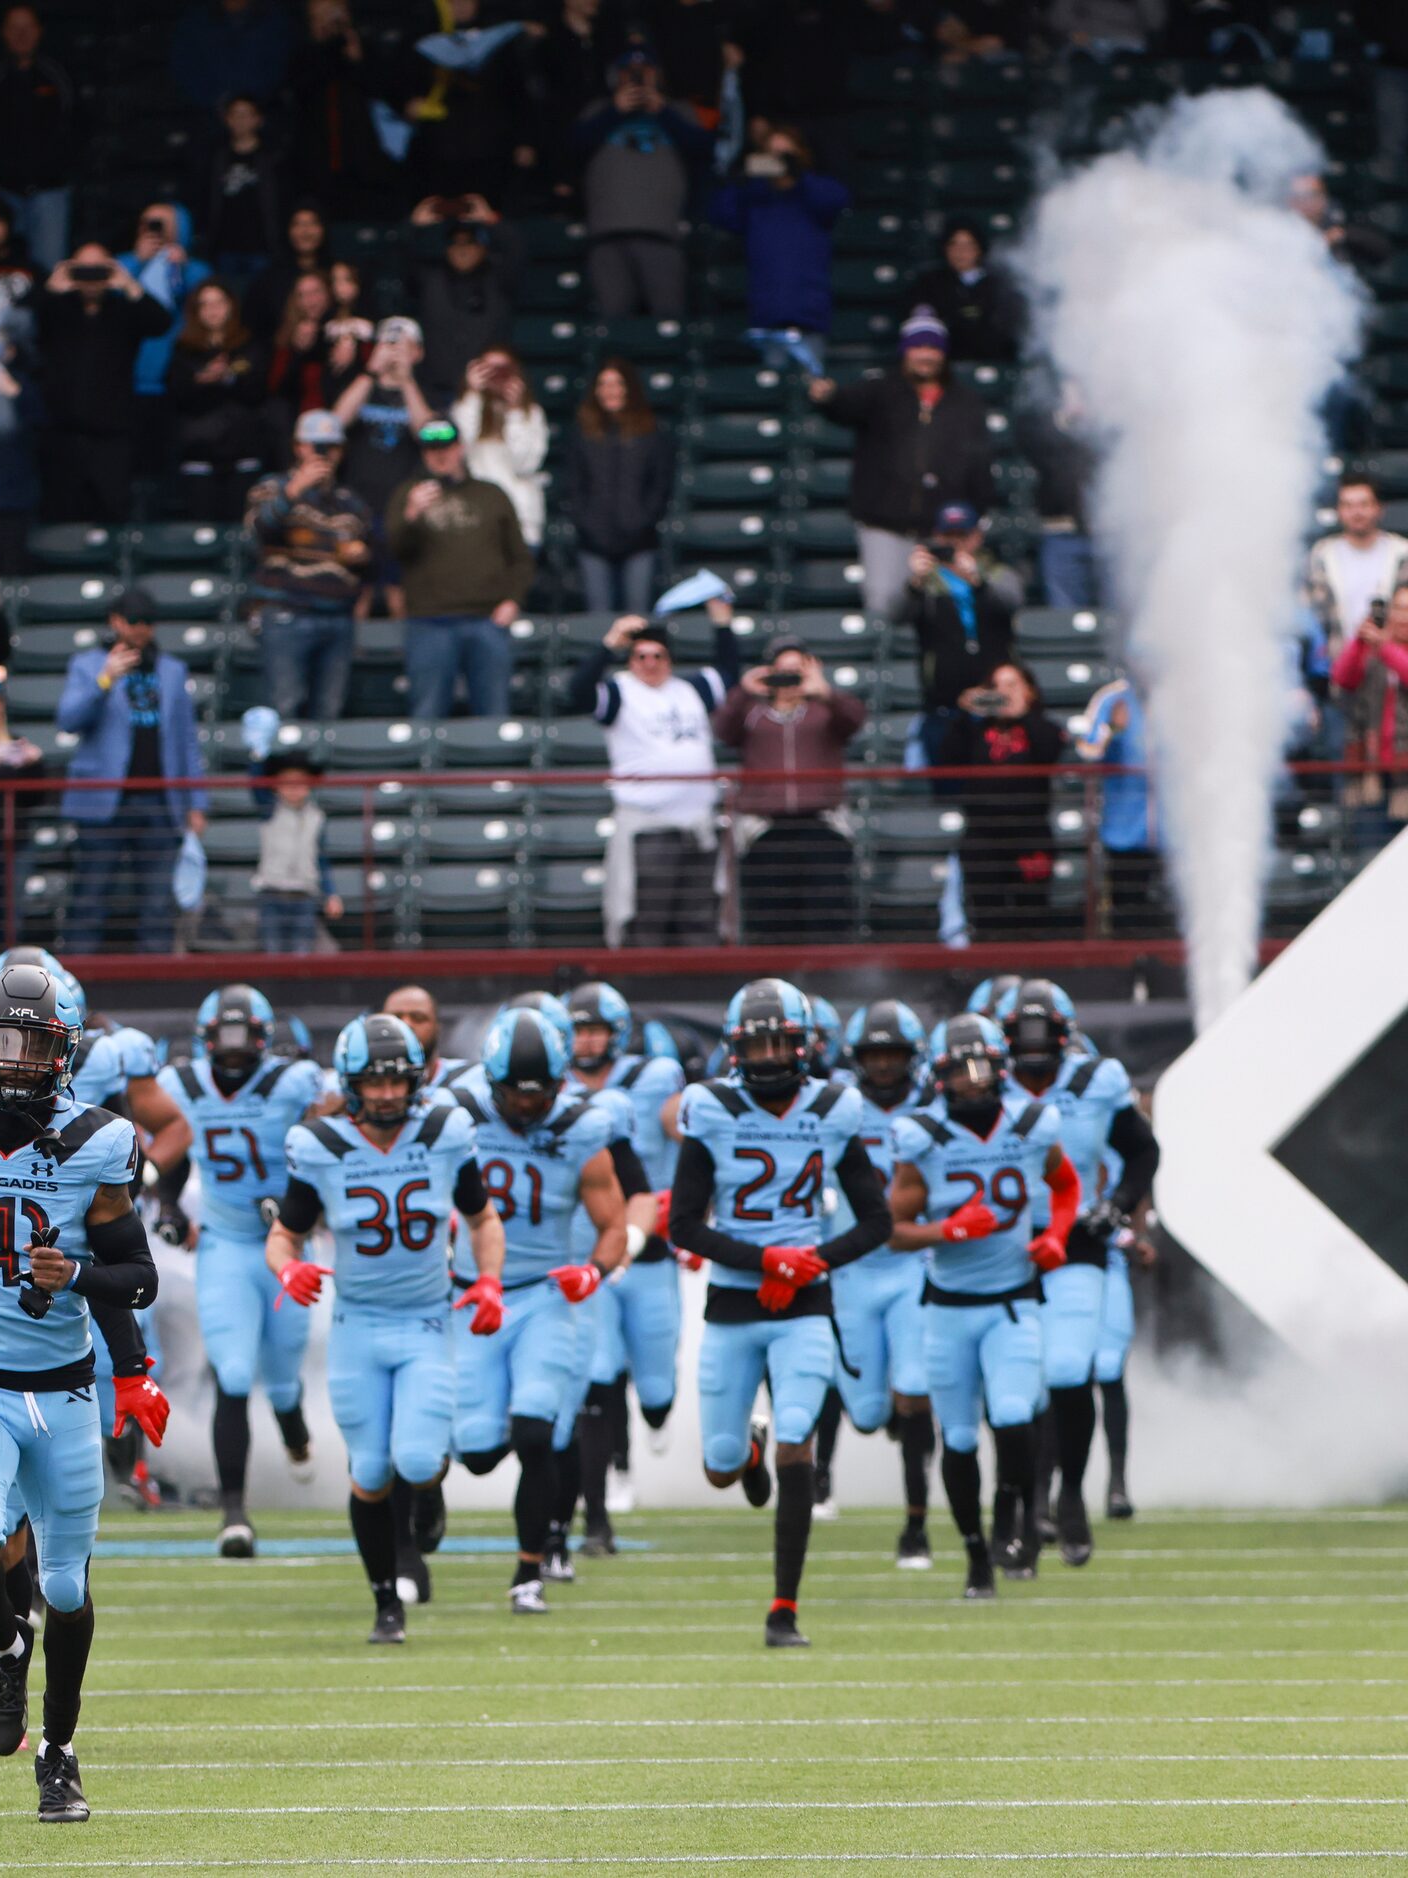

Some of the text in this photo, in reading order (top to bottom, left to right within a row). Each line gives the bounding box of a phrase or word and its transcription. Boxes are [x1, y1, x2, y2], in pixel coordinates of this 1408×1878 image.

[9, 1007, 39, 1019] XFL
[204, 1126, 268, 1182] 51
[733, 1147, 824, 1221] 24
[345, 1177, 437, 1257] 36
[481, 1159, 543, 1226] 81
